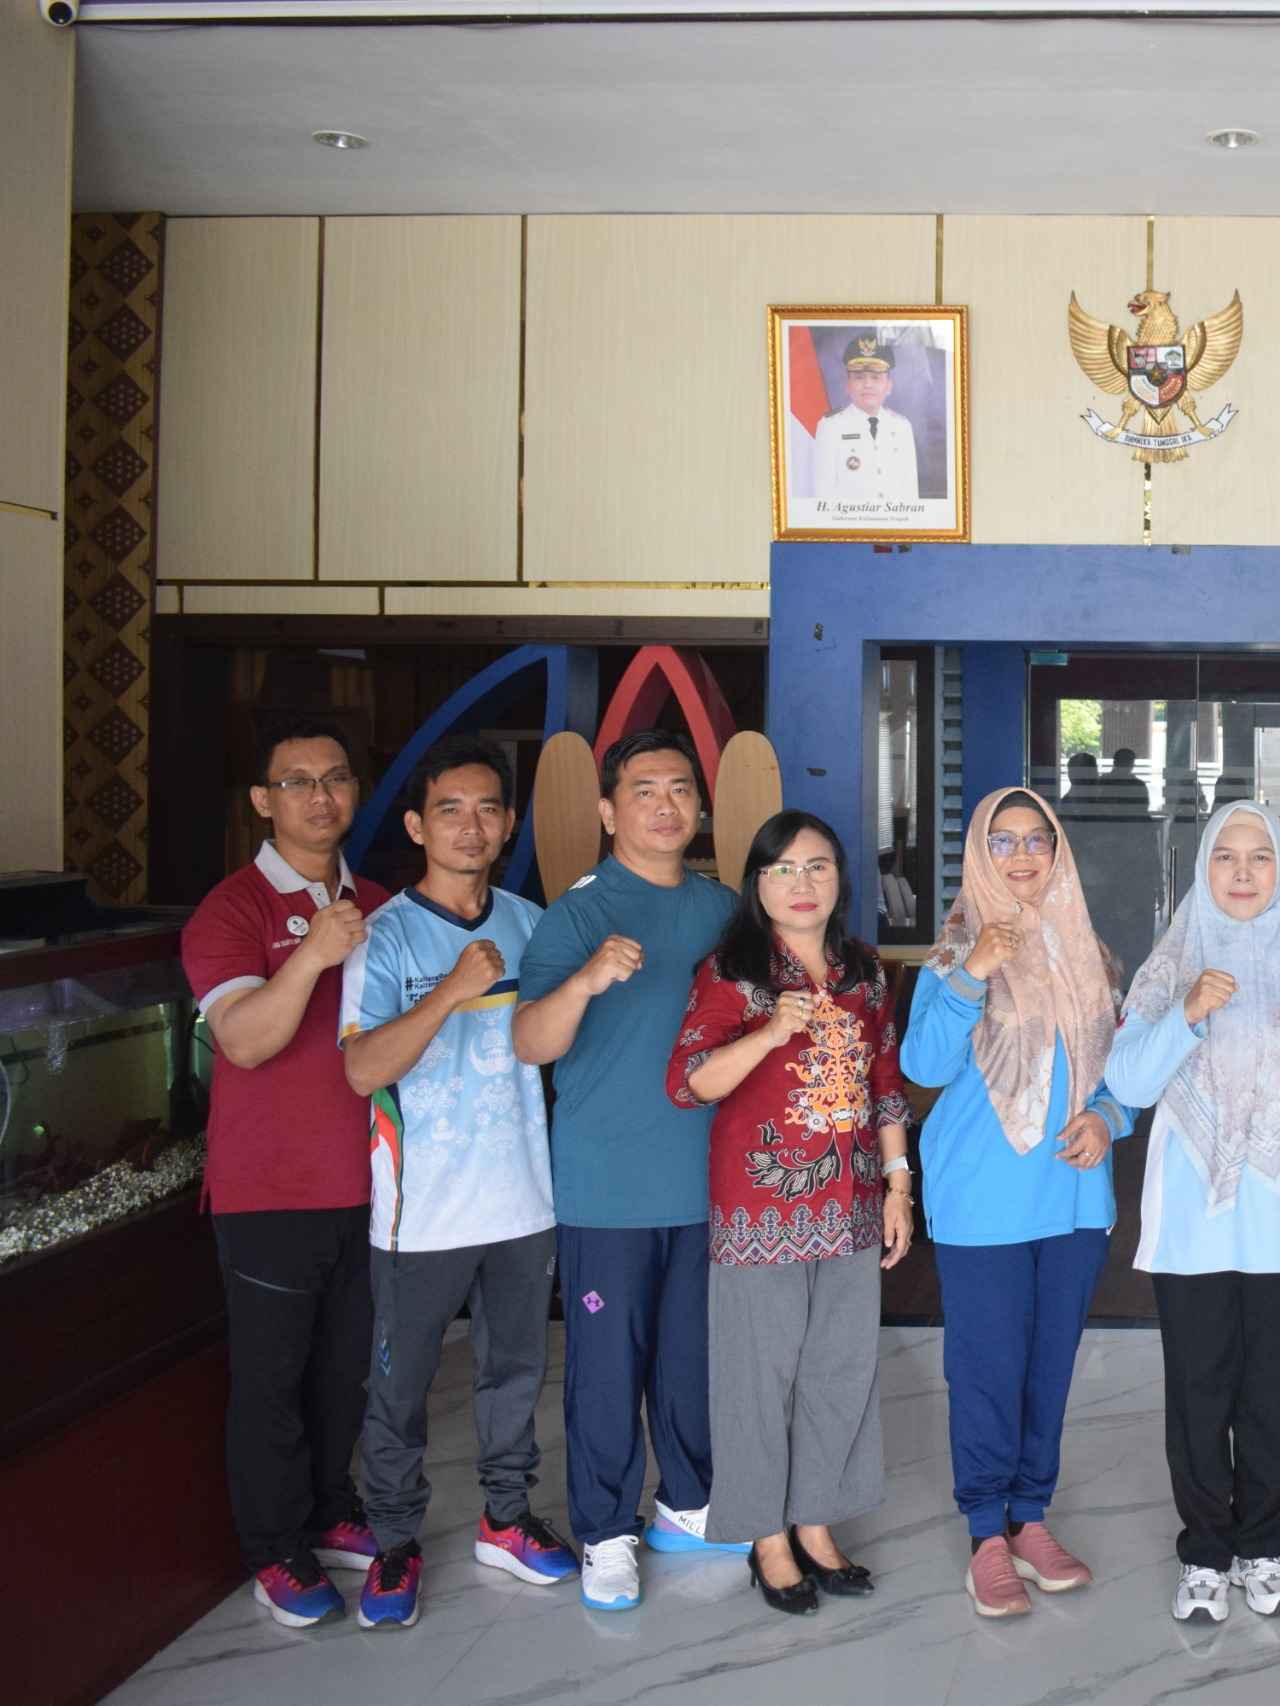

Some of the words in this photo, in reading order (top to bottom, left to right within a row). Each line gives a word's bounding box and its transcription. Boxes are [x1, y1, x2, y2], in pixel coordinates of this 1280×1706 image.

[816, 501, 830, 512] H.
[832, 501, 882, 514] Agustiar
[884, 501, 926, 513] Sabran
